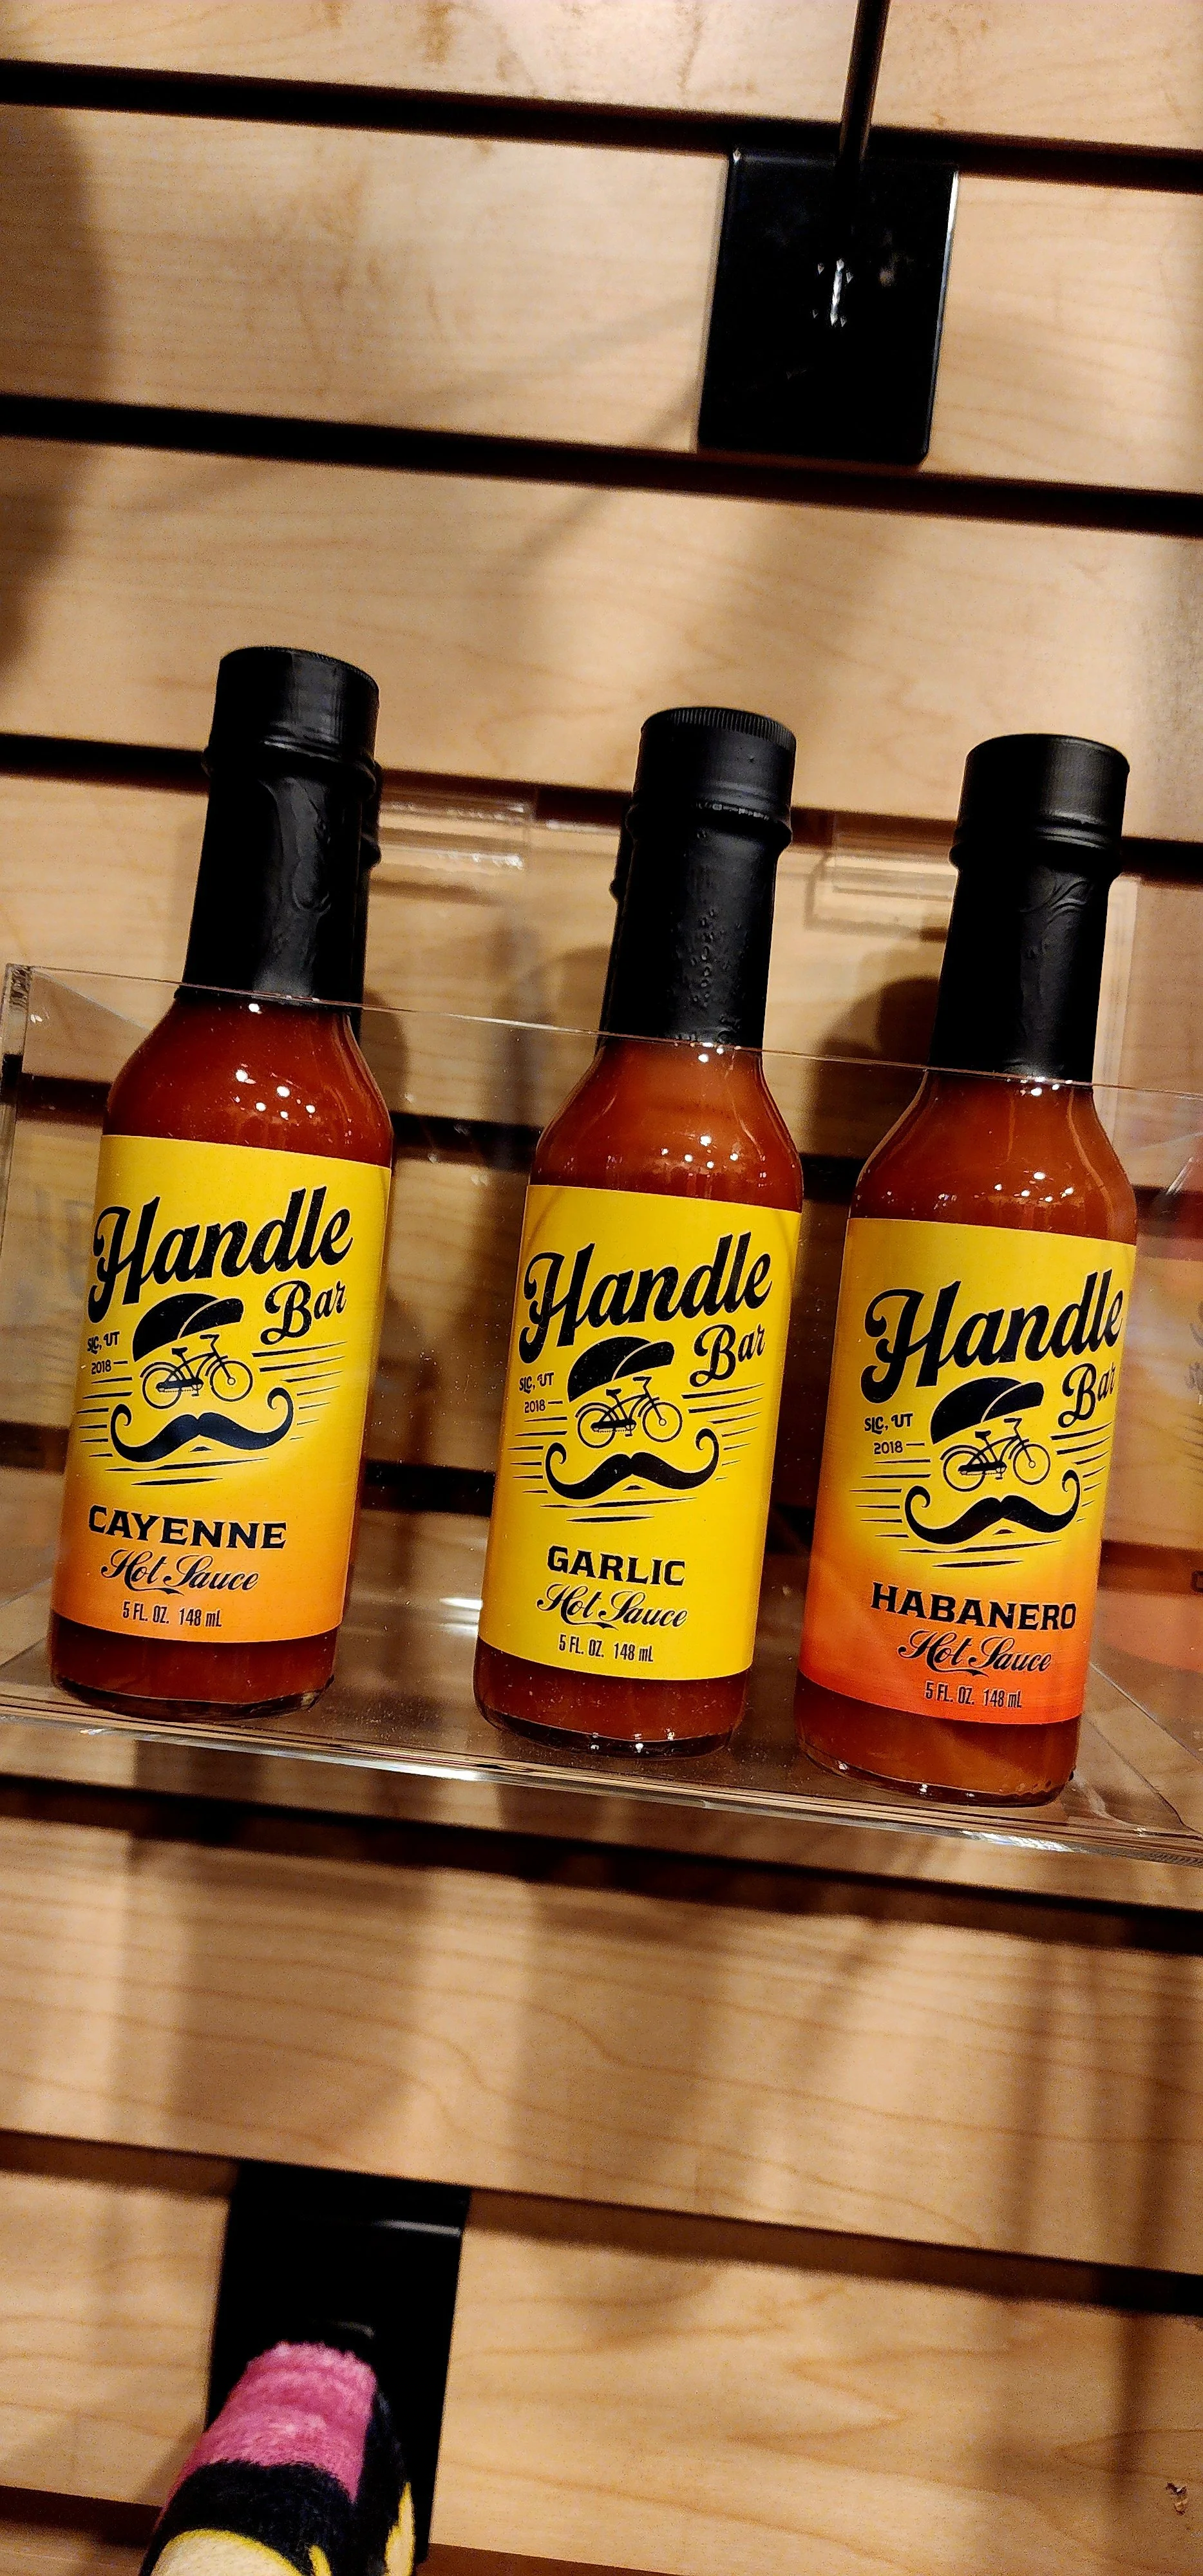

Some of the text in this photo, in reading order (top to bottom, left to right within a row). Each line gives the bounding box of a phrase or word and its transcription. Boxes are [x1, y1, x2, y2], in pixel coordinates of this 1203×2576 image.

[88, 1186, 354, 1323] Handle
[260, 1280, 346, 1345] Bar
[518, 1231, 772, 1364] Handle
[104, 1331, 120, 1347] UT
[690, 1323, 765, 1387] Bar
[860, 1269, 1124, 1403] Handle
[91, 1361, 111, 1374] 2018
[537, 1372, 554, 1387] UT
[524, 1399, 545, 1413] 2018
[1058, 1363, 1116, 1428] Bar
[891, 1412, 912, 1428] UT
[874, 1441, 902, 1454] 2018
[88, 1506, 287, 1549] CAYENNE
[101, 1549, 259, 1596] Hot Sauce
[547, 1545, 685, 1586] GARLIC
[123, 1602, 222, 1628] 5 FL. OZ. 148 mL
[536, 1584, 688, 1631] Hot Sauce
[871, 1582, 1076, 1629] HABANERO
[559, 1634, 653, 1662] 5 FL. OZ. 148 mL
[898, 1630, 1052, 1678] Hot Sauce
[925, 1682, 1022, 1708] 5 FL. OZ. 148 mL
